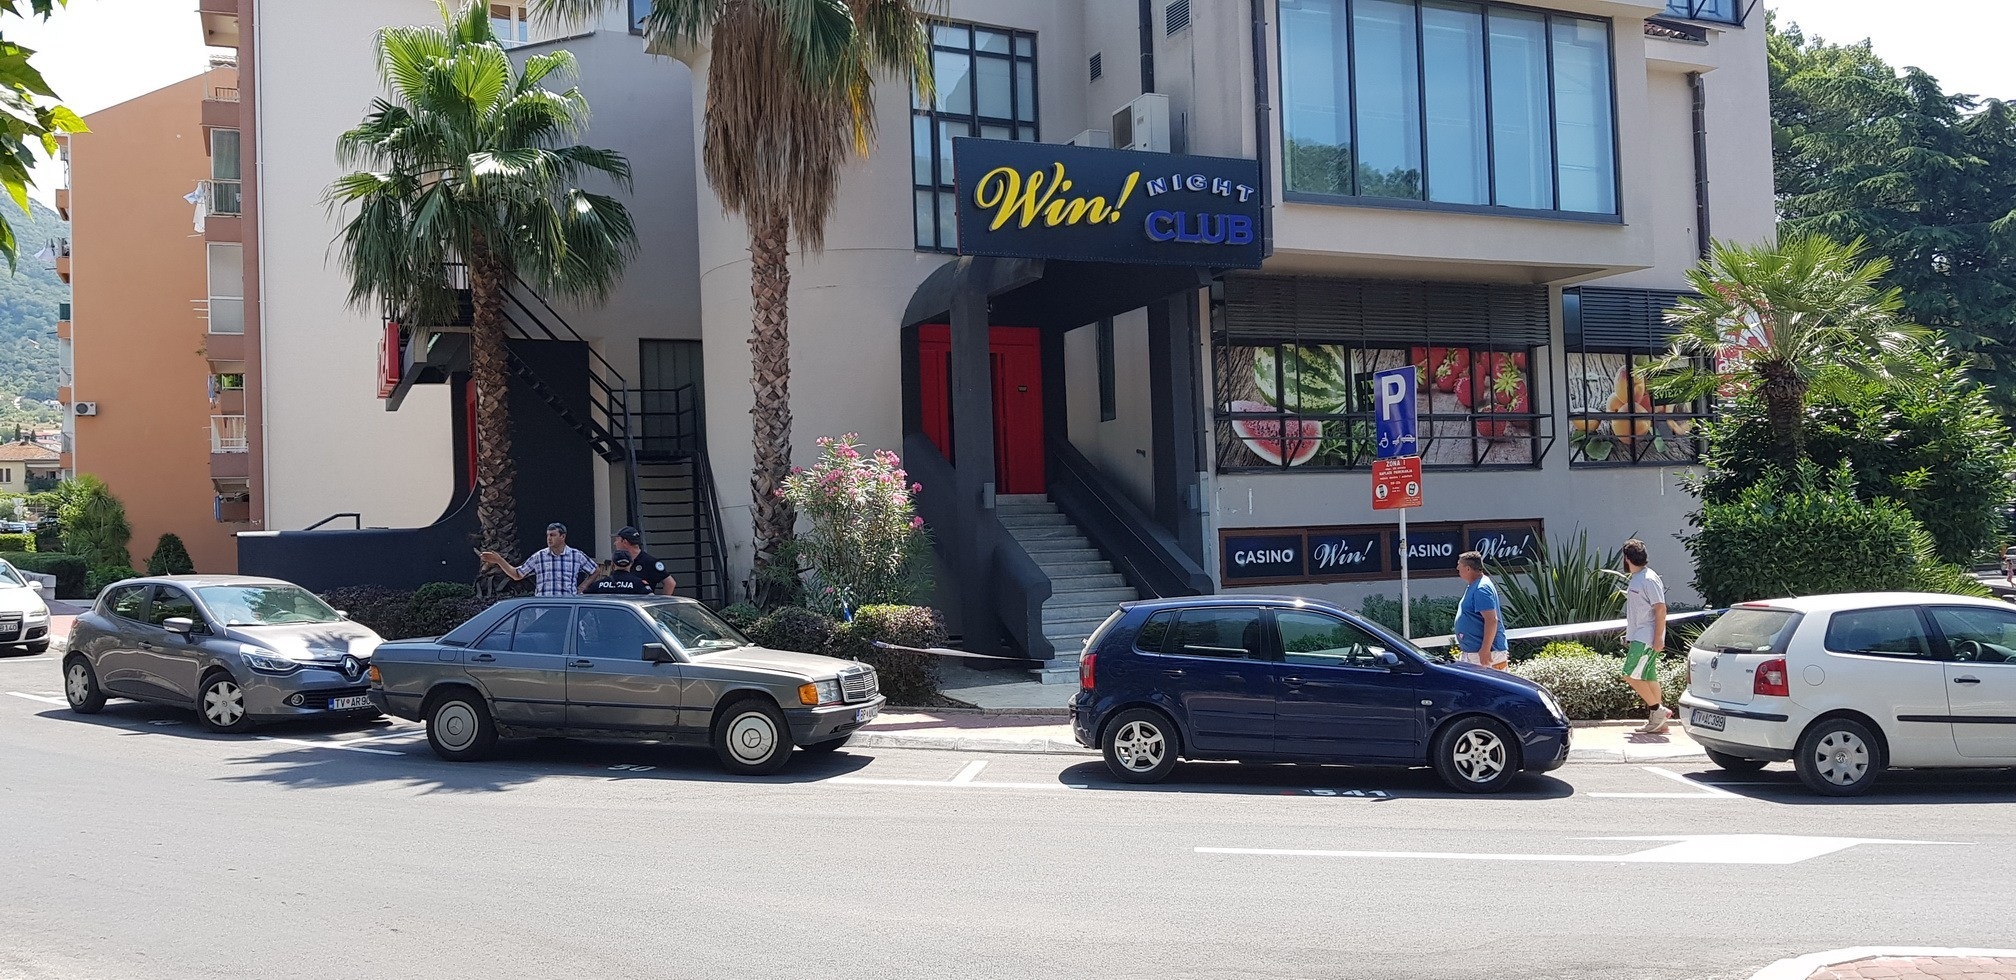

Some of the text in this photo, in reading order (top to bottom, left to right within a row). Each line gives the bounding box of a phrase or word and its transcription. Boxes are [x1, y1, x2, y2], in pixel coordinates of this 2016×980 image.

[974, 161, 1141, 231] Win!
[1146, 174, 1254, 202] NIGHT
[1144, 210, 1254, 245] CLUB
[1381, 374, 1406, 421] P
[1235, 549, 1294, 565] CASINO
[1314, 540, 1373, 568] Win!
[1475, 534, 1530, 561] Win!
[598, 581, 634, 589] POLCIJA
[335, 698, 345, 708] TV
